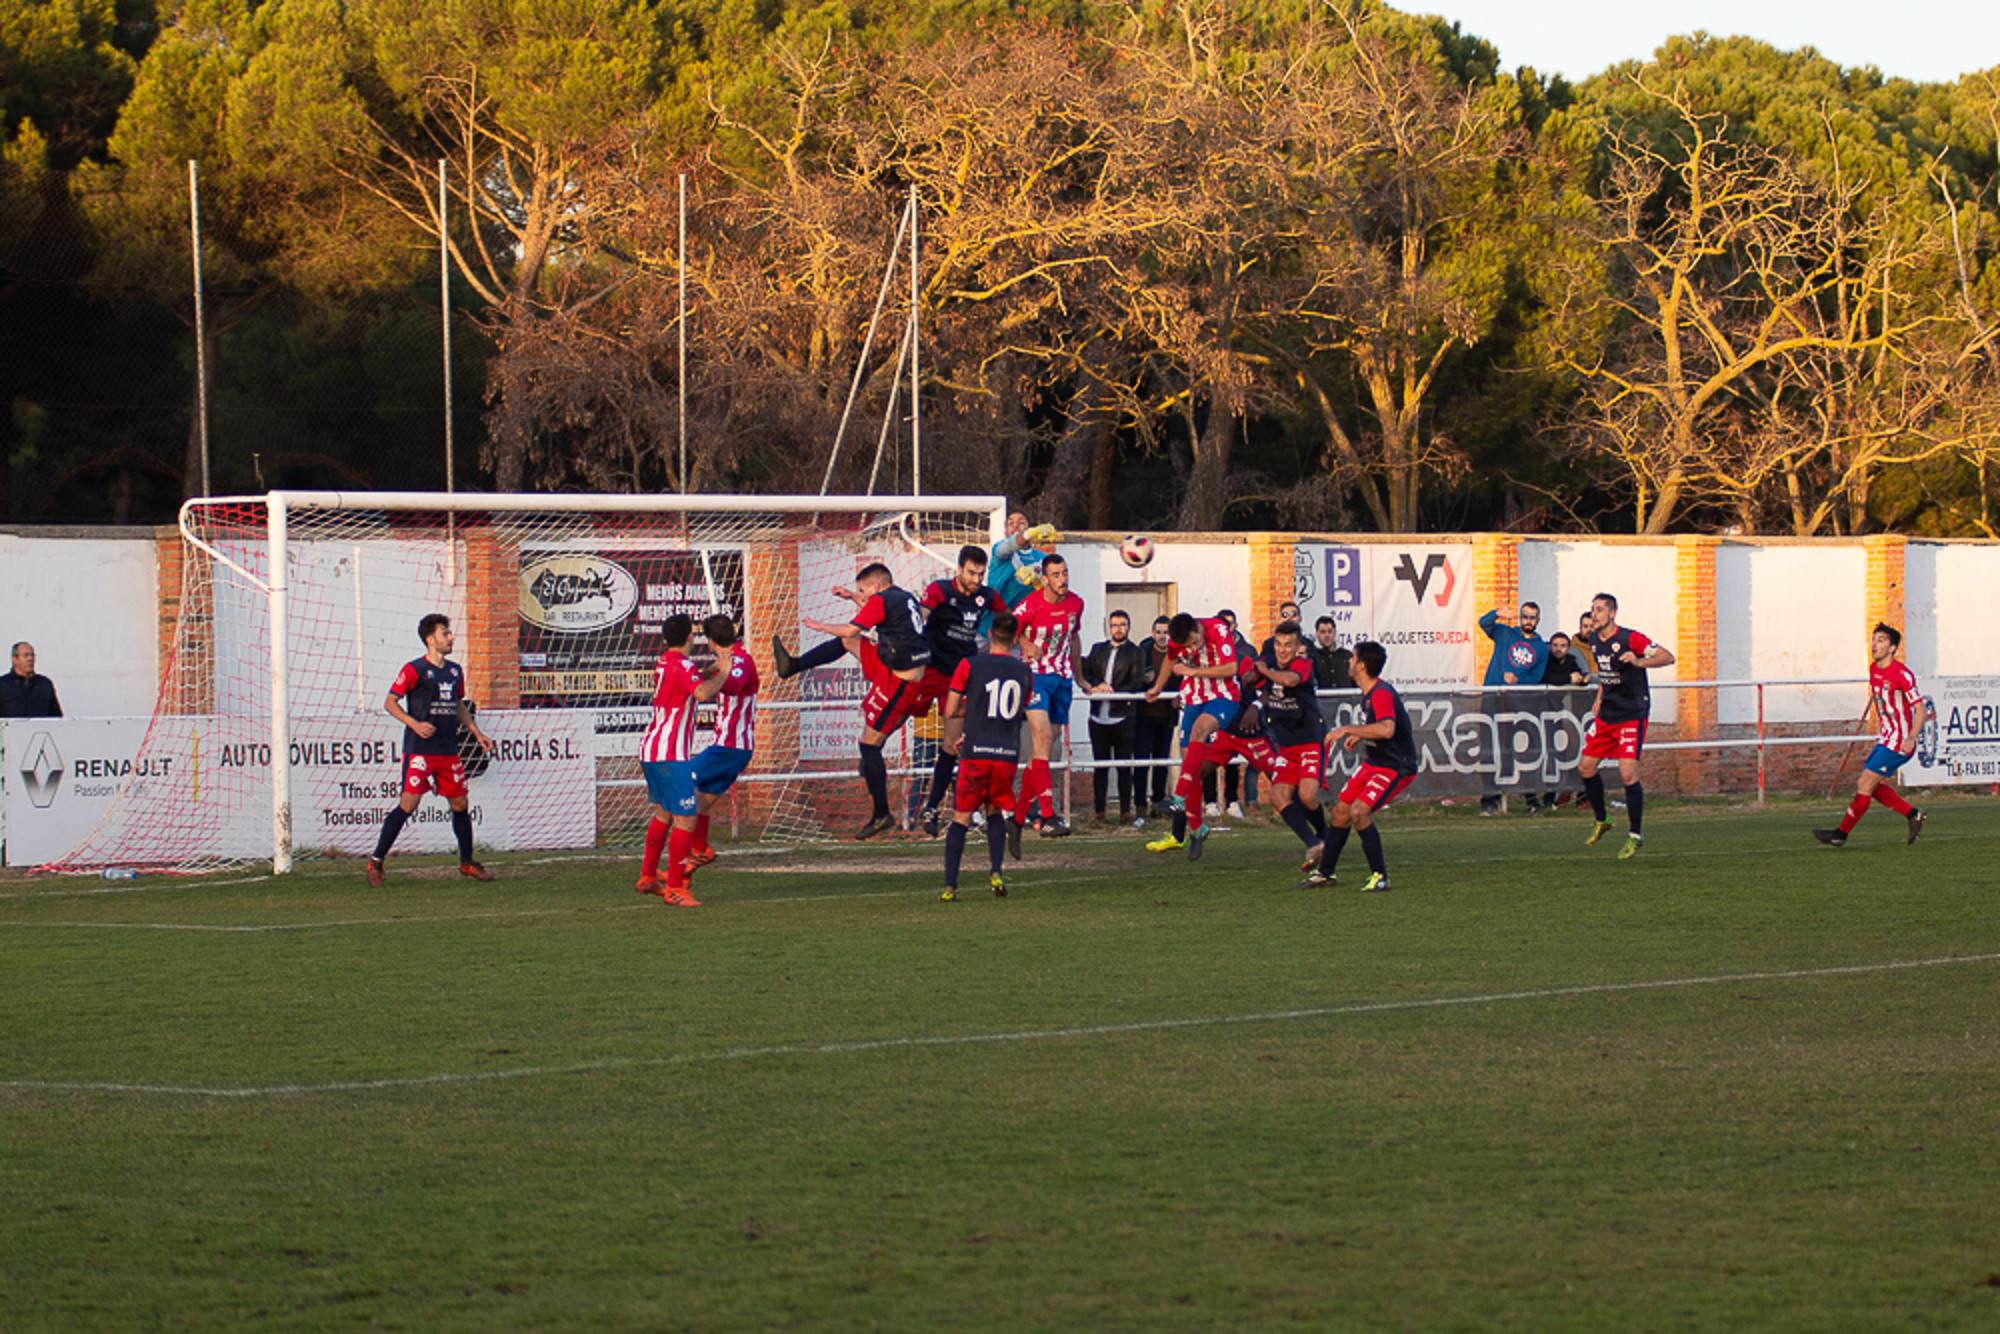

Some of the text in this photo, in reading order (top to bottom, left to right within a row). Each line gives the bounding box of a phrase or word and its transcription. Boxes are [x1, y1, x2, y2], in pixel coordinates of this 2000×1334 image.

[647, 582, 683, 601] MENÚS
[985, 678, 1021, 720] 10
[221, 738, 355, 766] AUTOÓVILES
[361, 741, 385, 765] DE
[488, 734, 543, 761] ARCÍA
[548, 737, 580, 761] S.L.
[74, 757, 172, 778] RENAULT
[73, 783, 115, 797] Passion
[339, 782, 376, 800] Tfno:
